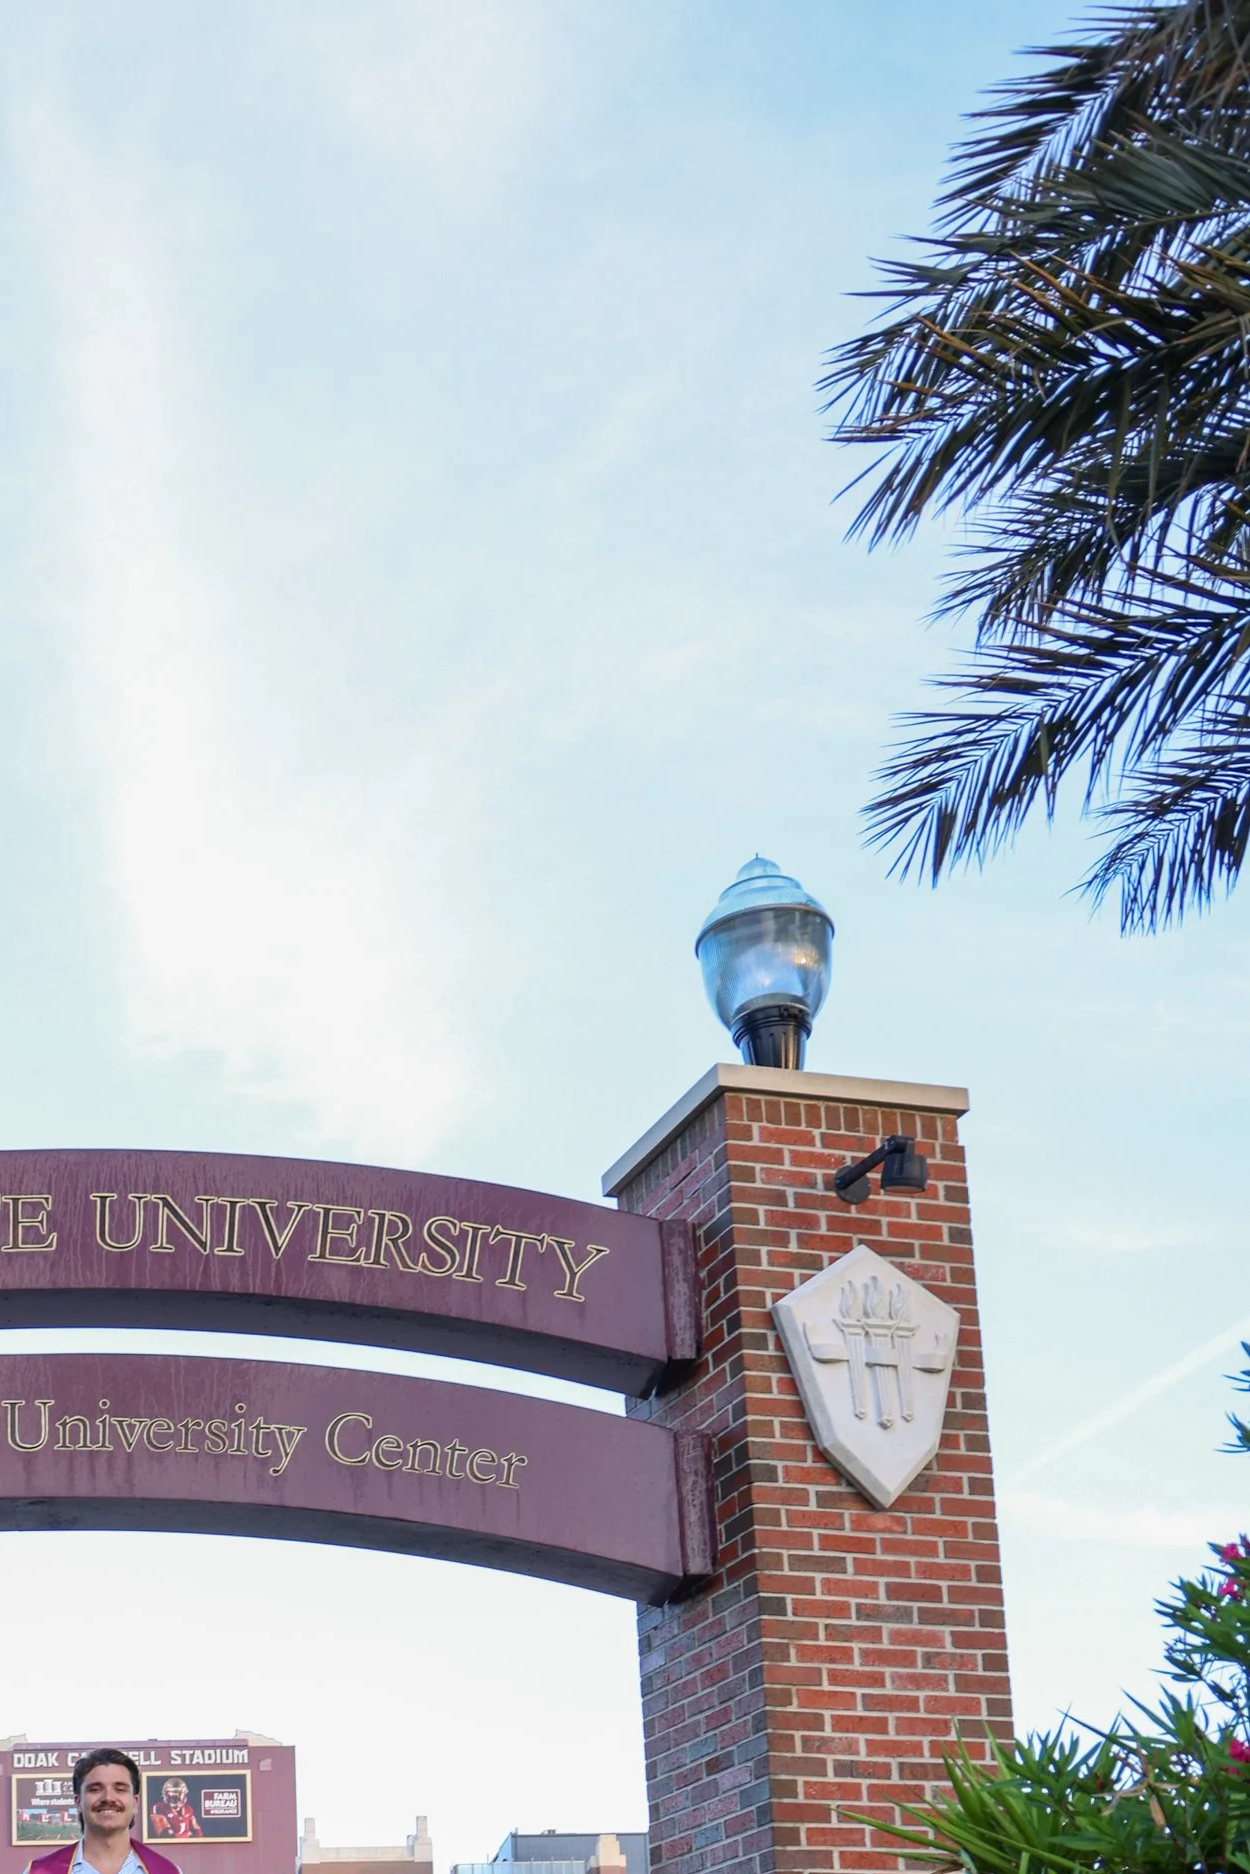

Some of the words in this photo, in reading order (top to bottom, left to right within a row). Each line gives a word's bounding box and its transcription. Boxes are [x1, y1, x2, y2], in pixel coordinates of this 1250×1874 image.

[90, 1192, 610, 1303] UNIVERSITY
[1, 1398, 308, 1477] University
[324, 1411, 528, 1489] Center
[13, 1752, 59, 1768] DOAK
[170, 1749, 249, 1765] STADIUM
[204, 1799, 238, 1807] BUREAU
